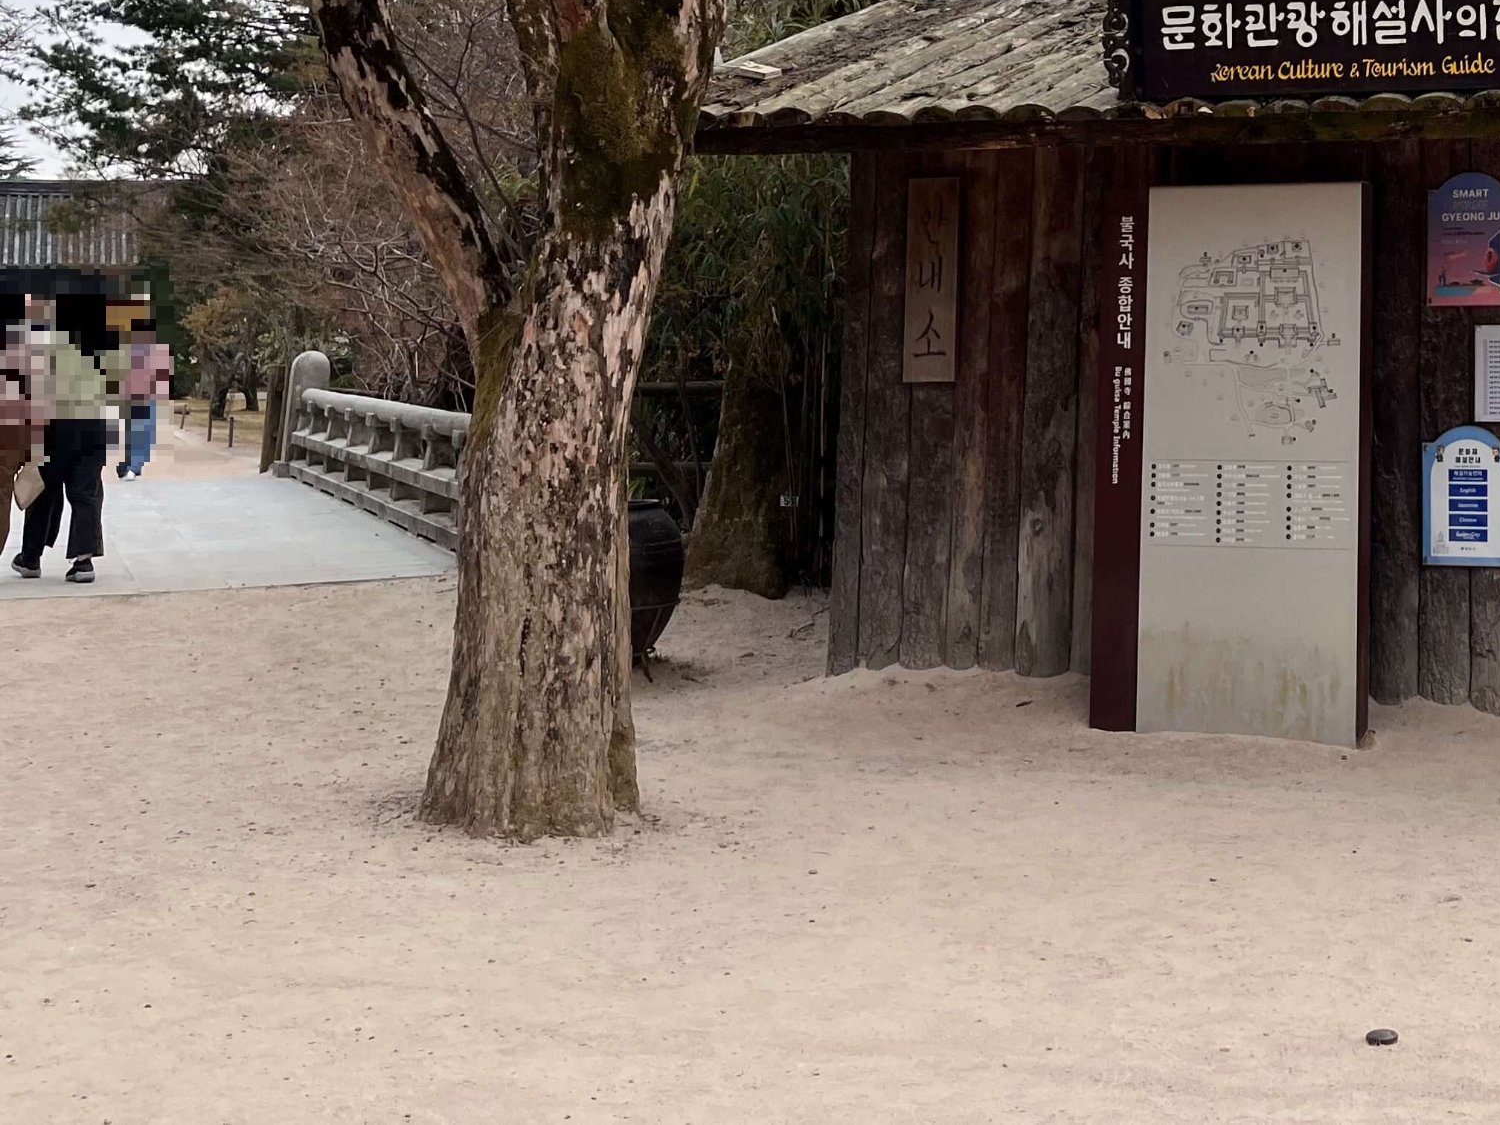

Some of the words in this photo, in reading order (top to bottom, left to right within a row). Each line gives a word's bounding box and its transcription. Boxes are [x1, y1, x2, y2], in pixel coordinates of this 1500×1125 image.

[1278, 59, 1344, 81] Culture
[1350, 64, 1359, 78] &
[1363, 56, 1435, 77] Tourism
[1442, 52, 1496, 75] Guide
[1452, 188, 1489, 198] SMART
[1442, 212, 1485, 222] GYEONG
[1487, 212, 1500, 221] JU
[1118, 215, 1135, 270] 불국사
[1116, 276, 1134, 350] 종합안내
[1112, 404, 1122, 434] Temple
[1111, 436, 1121, 485] Information
